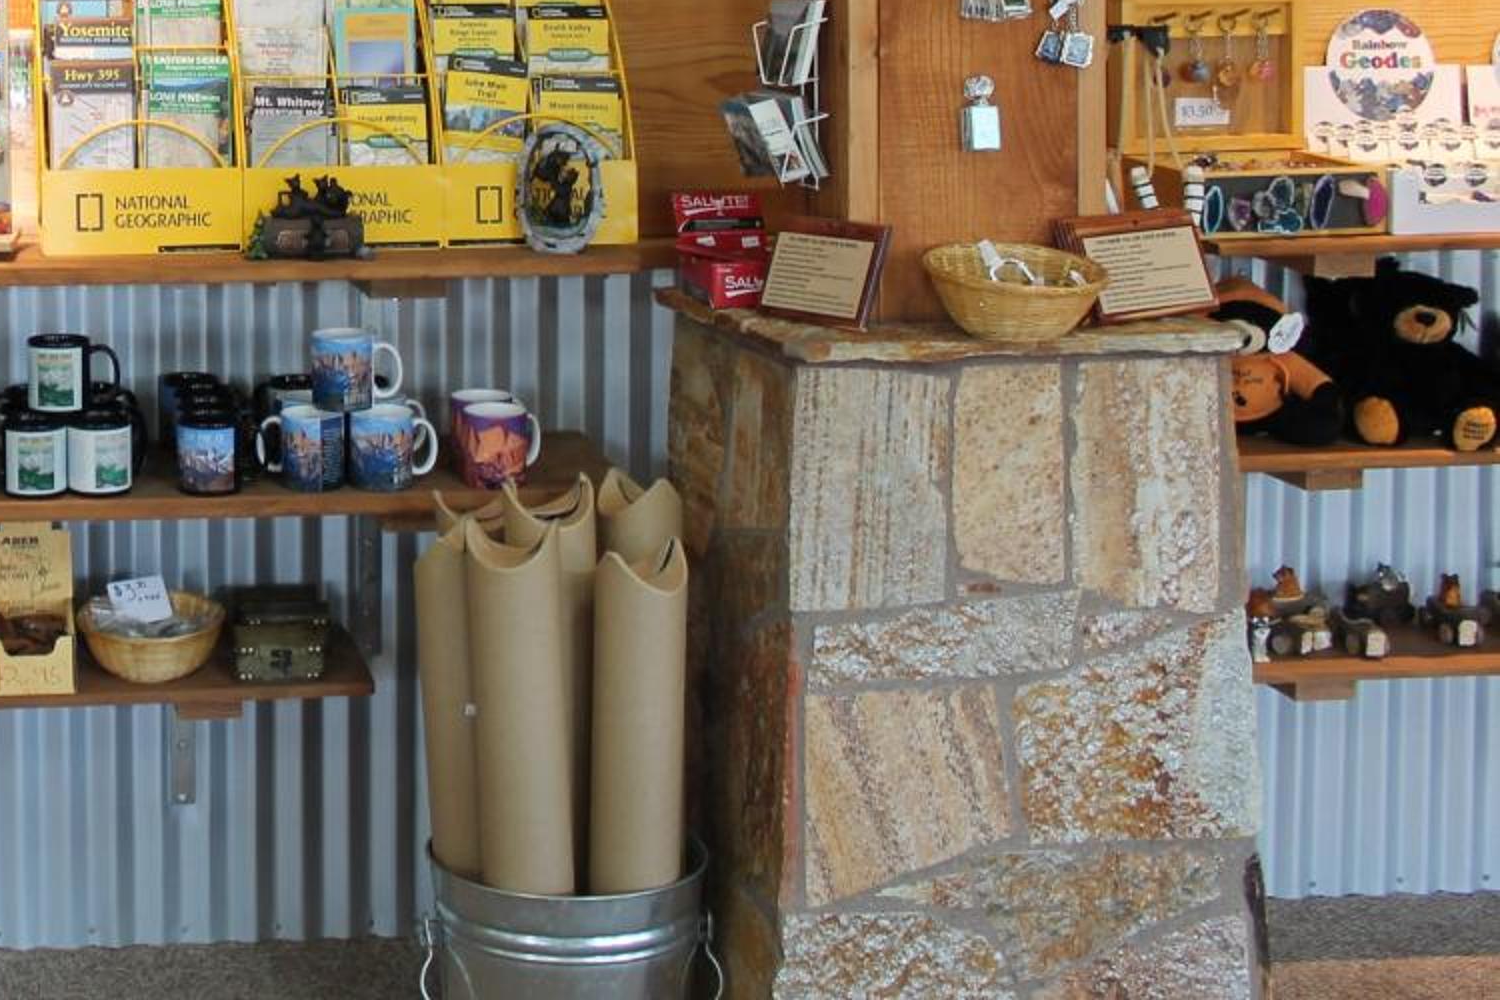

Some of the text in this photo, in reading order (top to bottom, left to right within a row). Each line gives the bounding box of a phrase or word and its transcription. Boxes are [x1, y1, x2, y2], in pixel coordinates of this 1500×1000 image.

[59, 22, 131, 38] Yosemite
[1351, 39, 1408, 50] Rainbow
[1339, 51, 1422, 69] Geodes
[64, 68, 120, 83] Hwy 395
[254, 95, 325, 109] Mt. Whitney
[114, 194, 190, 211] NATIONAL
[114, 210, 213, 229] GEOGRAPHIC
